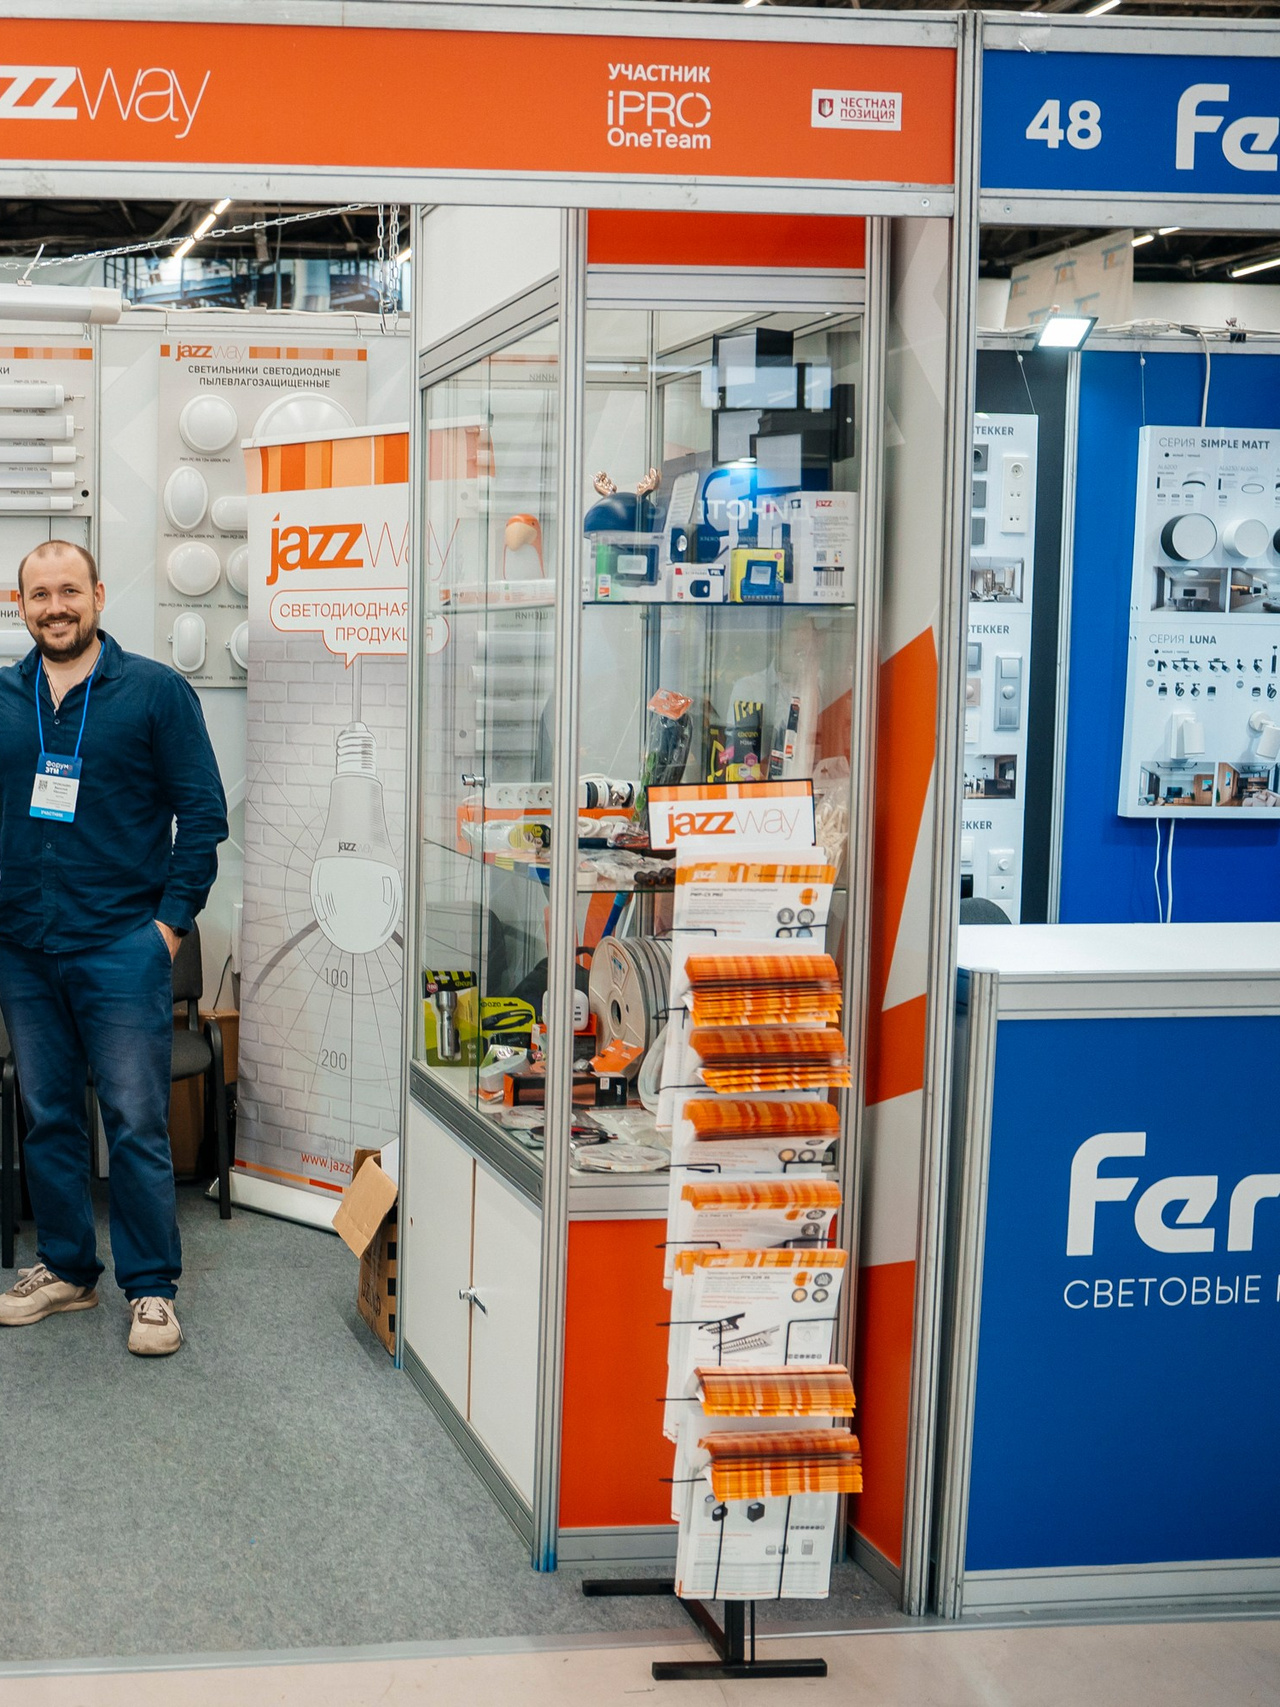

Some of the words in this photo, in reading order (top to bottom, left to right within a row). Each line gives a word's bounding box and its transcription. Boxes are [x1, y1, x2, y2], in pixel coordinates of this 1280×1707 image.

[607, 64, 710, 84] УЧАСТНИК
[840, 96, 896, 110] ЧЕСТНАЯ
[840, 107, 896, 121] ПОЗИЦИЯ
[1025, 99, 1103, 150] 48
[607, 127, 711, 150] OneTeam
[175, 341, 248, 361] jazzway
[188, 365, 258, 375] СВЕТИЛЬНИКИ
[263, 366, 341, 377] СВЕТОДИОДНЫЕ
[199, 377, 330, 388] ПЫЛЕВЛАГОЗАЩИЩЕННЫЕ
[1158, 437, 1196, 447] СЕРИЯ
[1201, 439, 1239, 449] SIMPLE
[1242, 440, 1270, 449] MATT
[266, 513, 459, 586] jazzwy
[280, 603, 408, 621] СВЕТОДИОДНАЯ
[1149, 634, 1185, 644] СЕРИЯ
[1189, 635, 1217, 644] LUNA
[45, 767, 59, 775] ЭТМ
[666, 806, 800, 844] jazzway
[324, 967, 348, 988] 100
[321, 1049, 347, 1071] 200
[1064, 1275, 1262, 1309] СВЕТОВЫЕ
